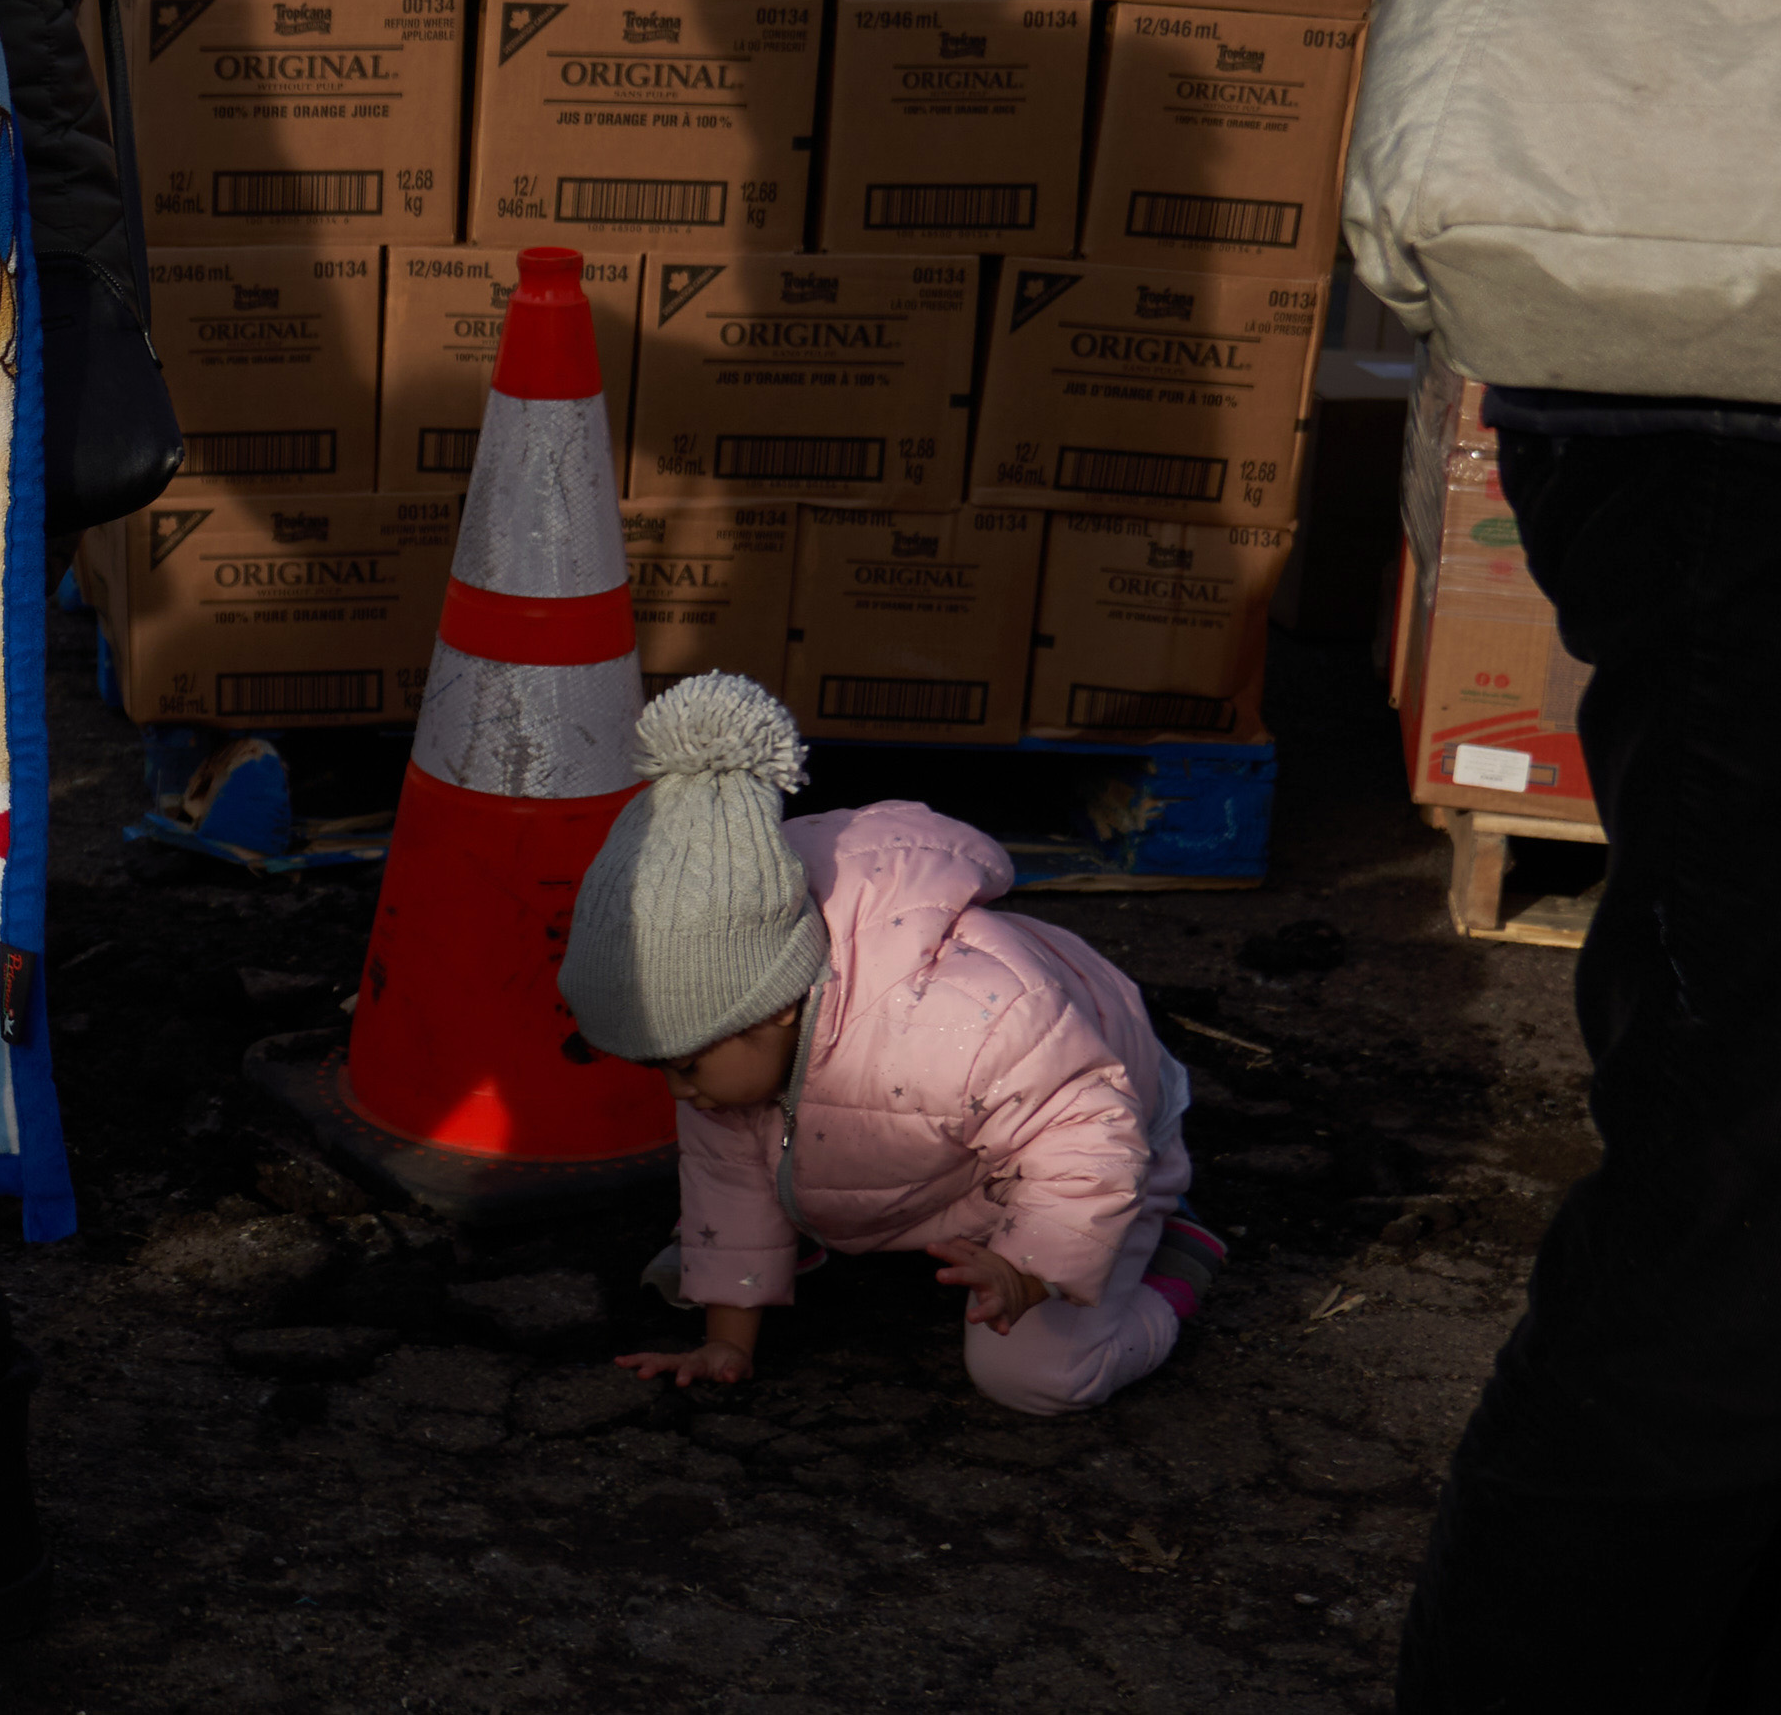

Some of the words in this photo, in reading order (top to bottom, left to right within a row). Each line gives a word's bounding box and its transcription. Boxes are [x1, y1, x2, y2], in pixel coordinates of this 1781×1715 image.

[273, 3, 332, 22] Tropicana
[623, 10, 681, 30] Tropicana
[756, 8, 809, 25] 00134
[1023, 11, 1077, 28] 00134
[384, 18, 421, 29] REFUND
[423, 18, 455, 29] WHERE
[401, 30, 455, 41] APPLICABLE
[1303, 30, 1356, 49] 00134
[1217, 44, 1265, 62] Tropicana
[214, 55, 392, 80] ORIGINAL
[561, 62, 736, 89] ORIGINAL
[902, 71, 1020, 89] ORIGINAL
[1176, 81, 1293, 107] ORIGINAL
[213, 106, 248, 119] 100%
[254, 106, 288, 118] PURE
[293, 105, 346, 118] ORANGE
[351, 105, 390, 118] JUICE
[556, 112, 579, 125] JUS
[585, 113, 647, 127] D'ORANGE
[653, 114, 678, 127] PUR
[169, 171, 194, 192] 12/
[396, 170, 433, 191] 12.68
[404, 192, 423, 216] kg
[314, 260, 368, 279] 00134
[407, 260, 463, 279] 12/946
[581, 264, 628, 282] 0134
[913, 267, 966, 284] 00134
[1136, 285, 1194, 308] Tropicana
[199, 321, 313, 341] ORIGINAL
[720, 322, 891, 349] ORIGINAL
[1071, 334, 1243, 370] ORIGINAL
[398, 504, 450, 521] 00134
[735, 510, 786, 526] 00134
[975, 513, 1028, 531] 00134
[1230, 529, 1281, 548] 00134
[214, 560, 387, 587] ORIGINAL
[855, 566, 967, 586] ORIGINAL
[1109, 575, 1222, 603] ORIGINAL
[680, 611, 717, 625] JUICE
